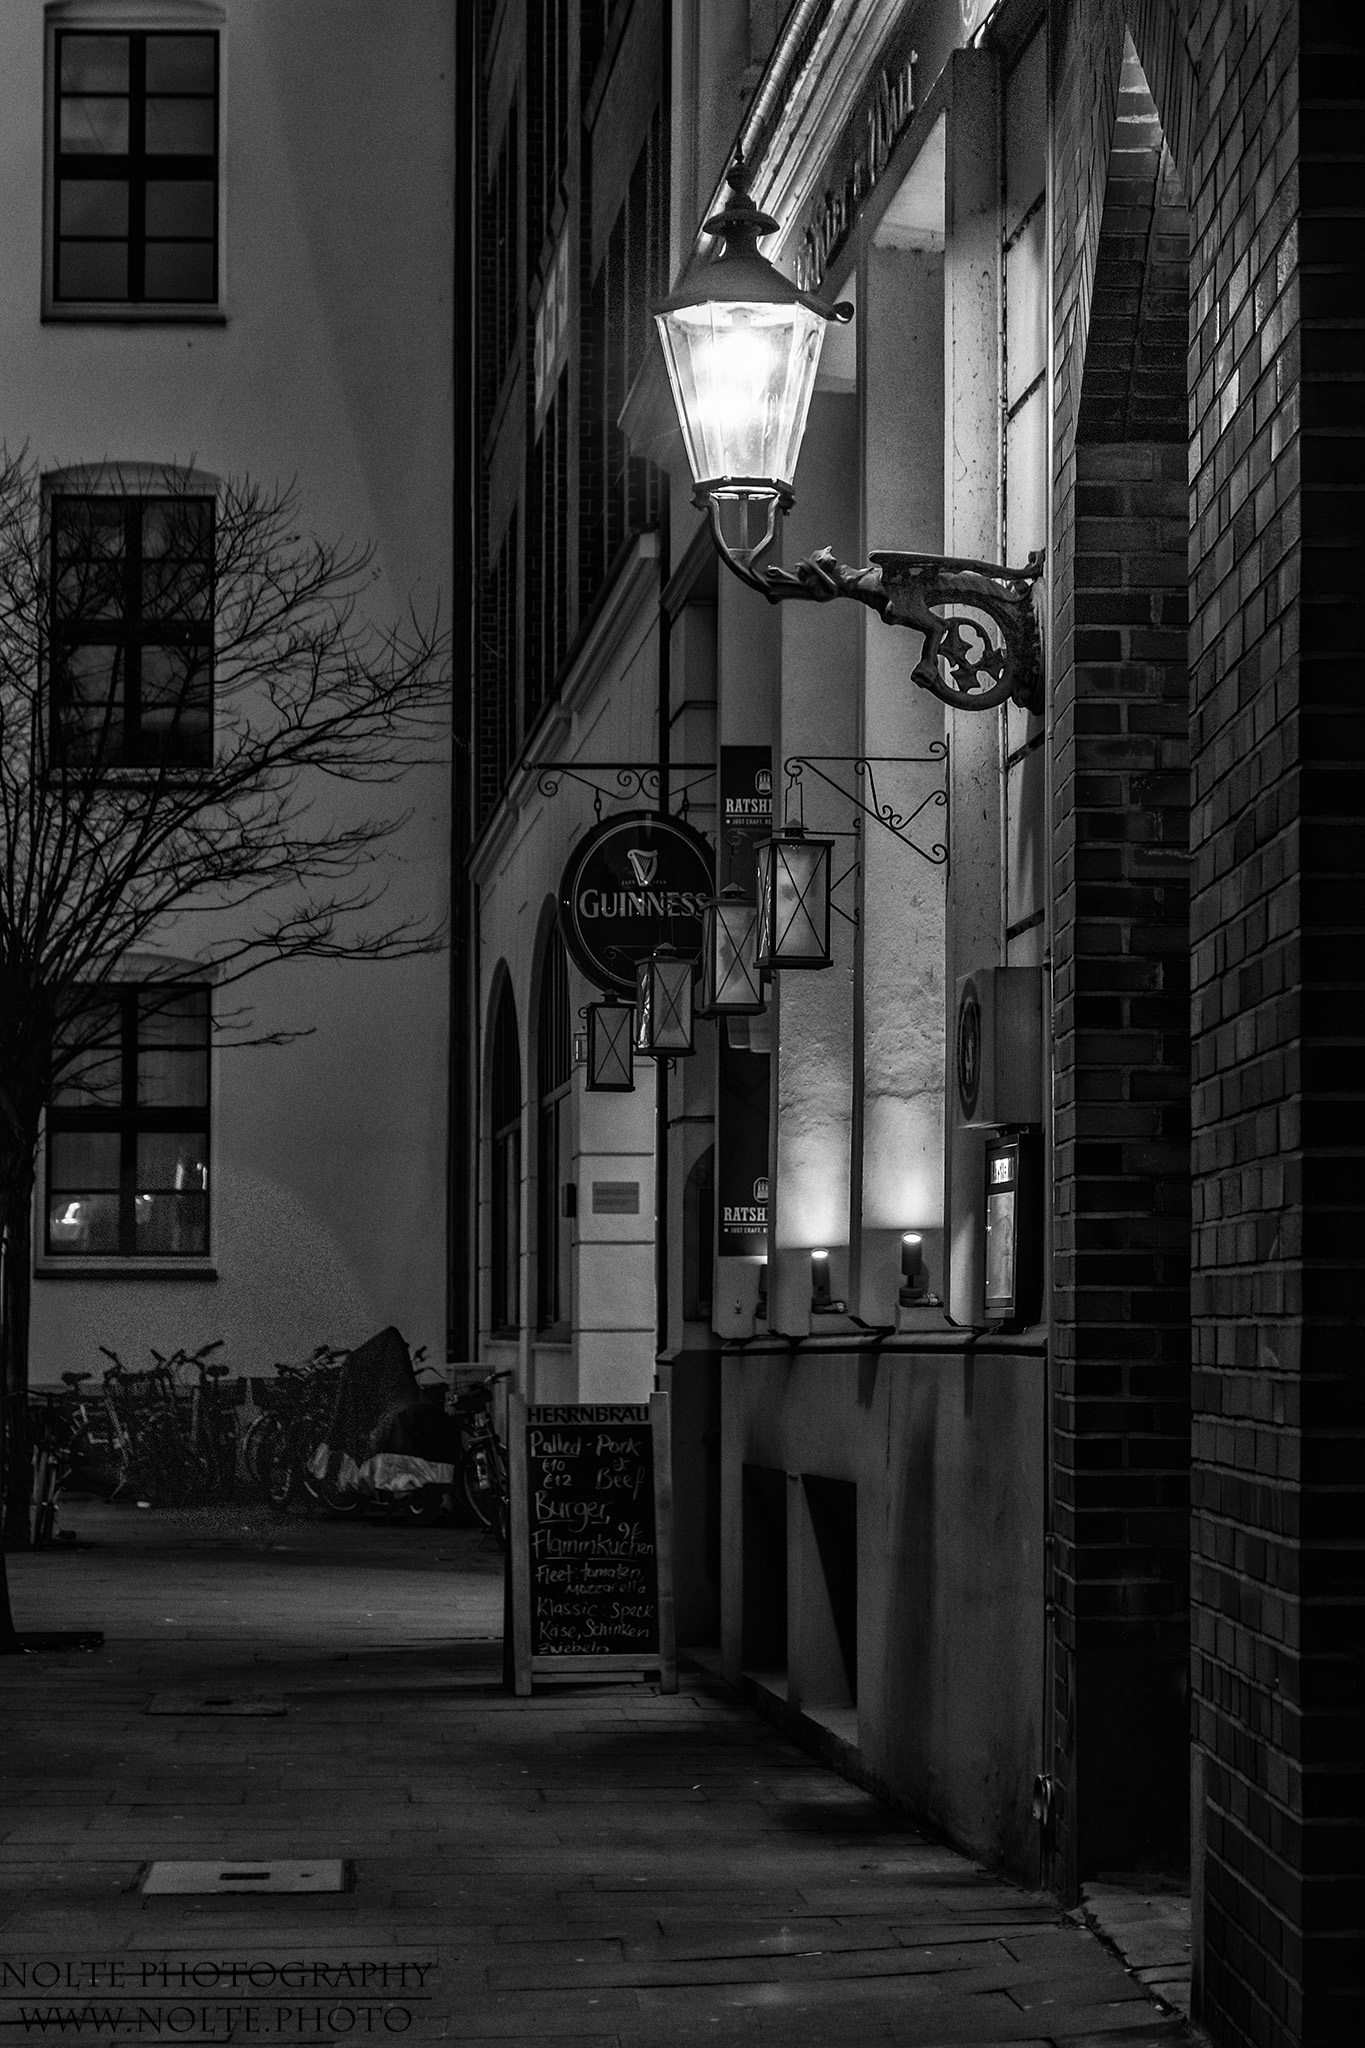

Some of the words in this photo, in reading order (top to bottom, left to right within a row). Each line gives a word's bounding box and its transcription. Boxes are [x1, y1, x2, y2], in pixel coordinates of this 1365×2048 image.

[723, 1207, 769, 1221] RATSH
[528, 1406, 649, 1423] HERRNBRÄU
[595, 1465, 646, 1501] Beef
